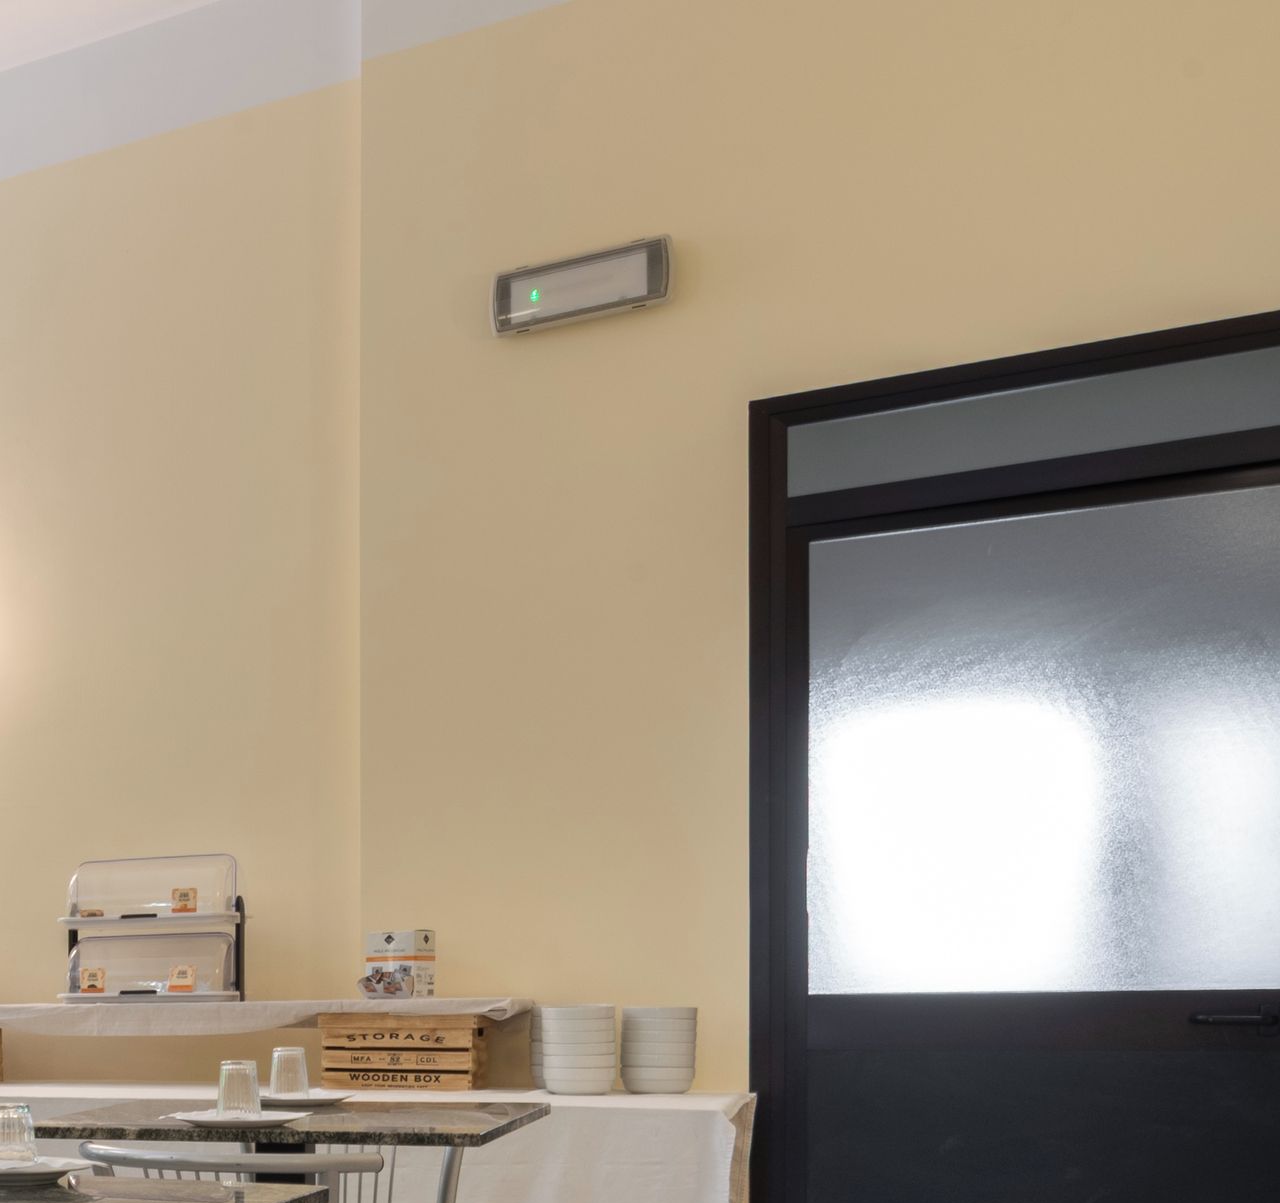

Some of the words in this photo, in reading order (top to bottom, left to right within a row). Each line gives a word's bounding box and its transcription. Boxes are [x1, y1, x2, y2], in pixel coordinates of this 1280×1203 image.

[346, 1032, 446, 1044] STORAGE
[349, 1073, 408, 1082] WOODEN
[414, 1074, 441, 1083] BOX
